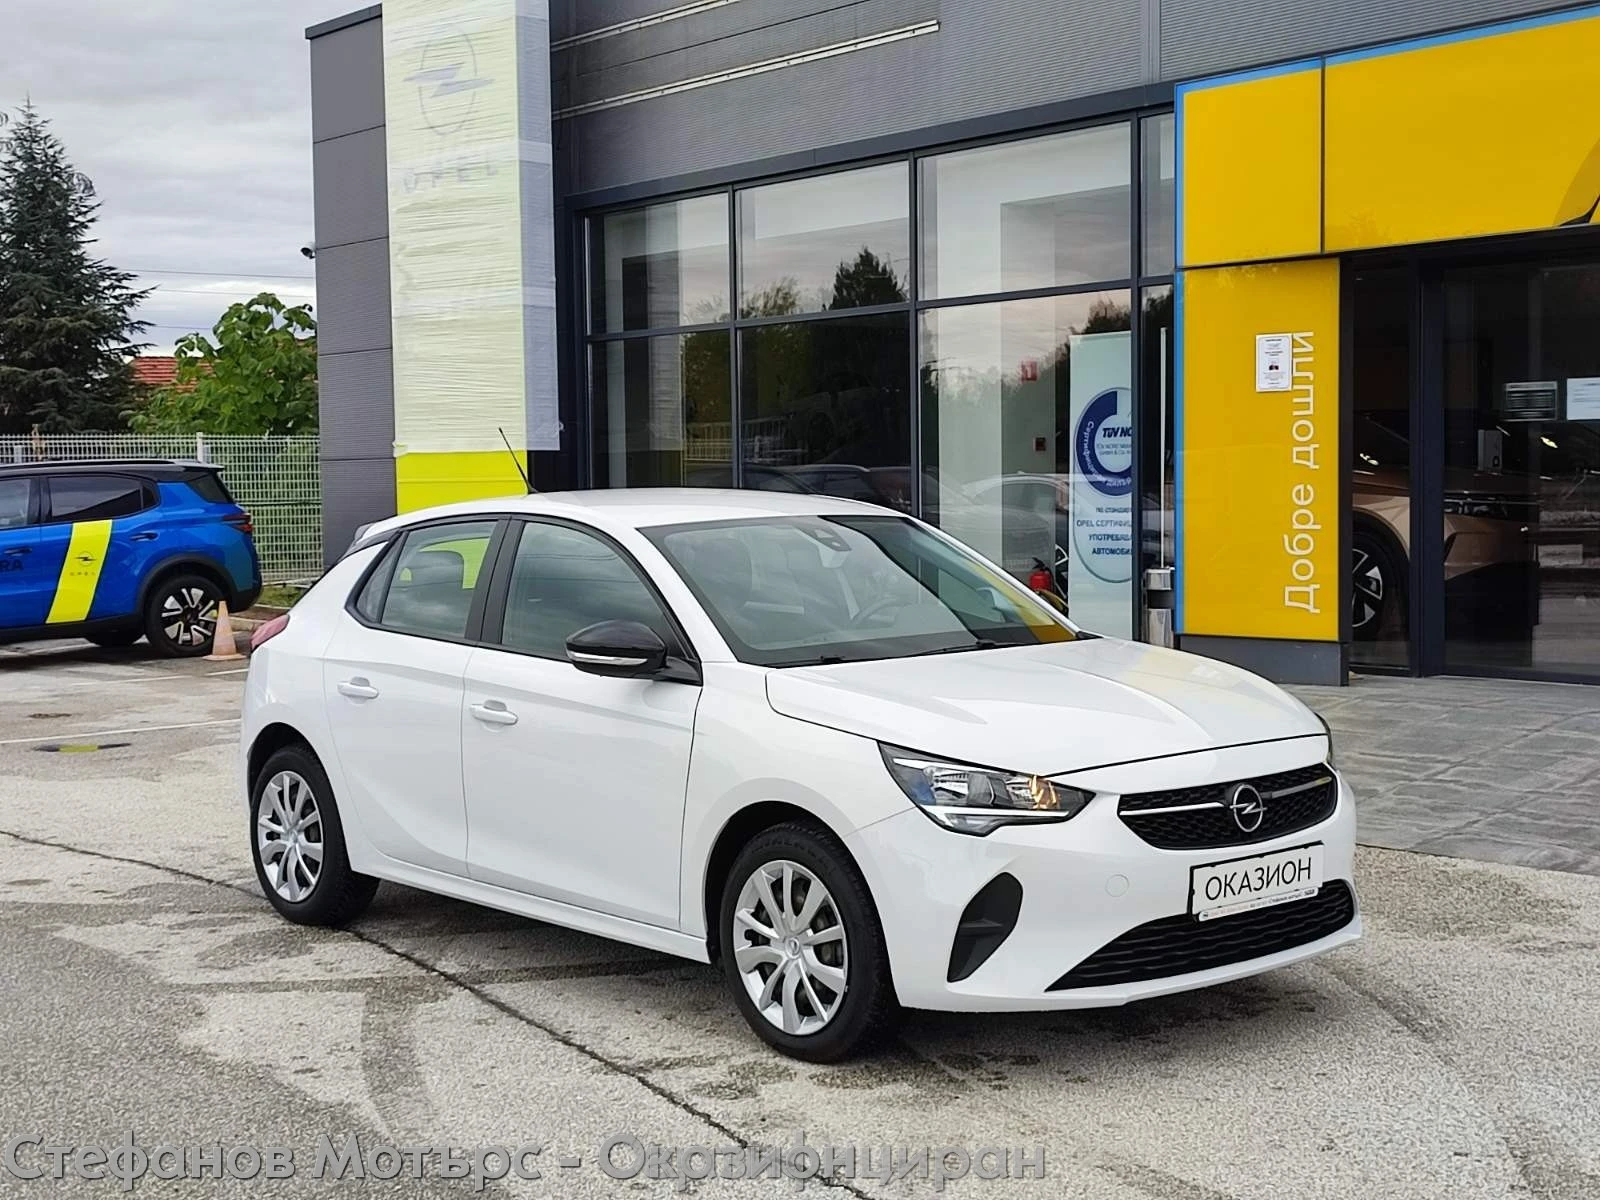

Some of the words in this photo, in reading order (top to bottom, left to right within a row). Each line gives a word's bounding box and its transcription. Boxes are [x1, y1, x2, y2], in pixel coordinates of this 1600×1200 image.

[1292, 332, 1320, 469] дошли
[1283, 484, 1322, 613] Добре
[1205, 857, 1311, 900] ОКАЗИОН
